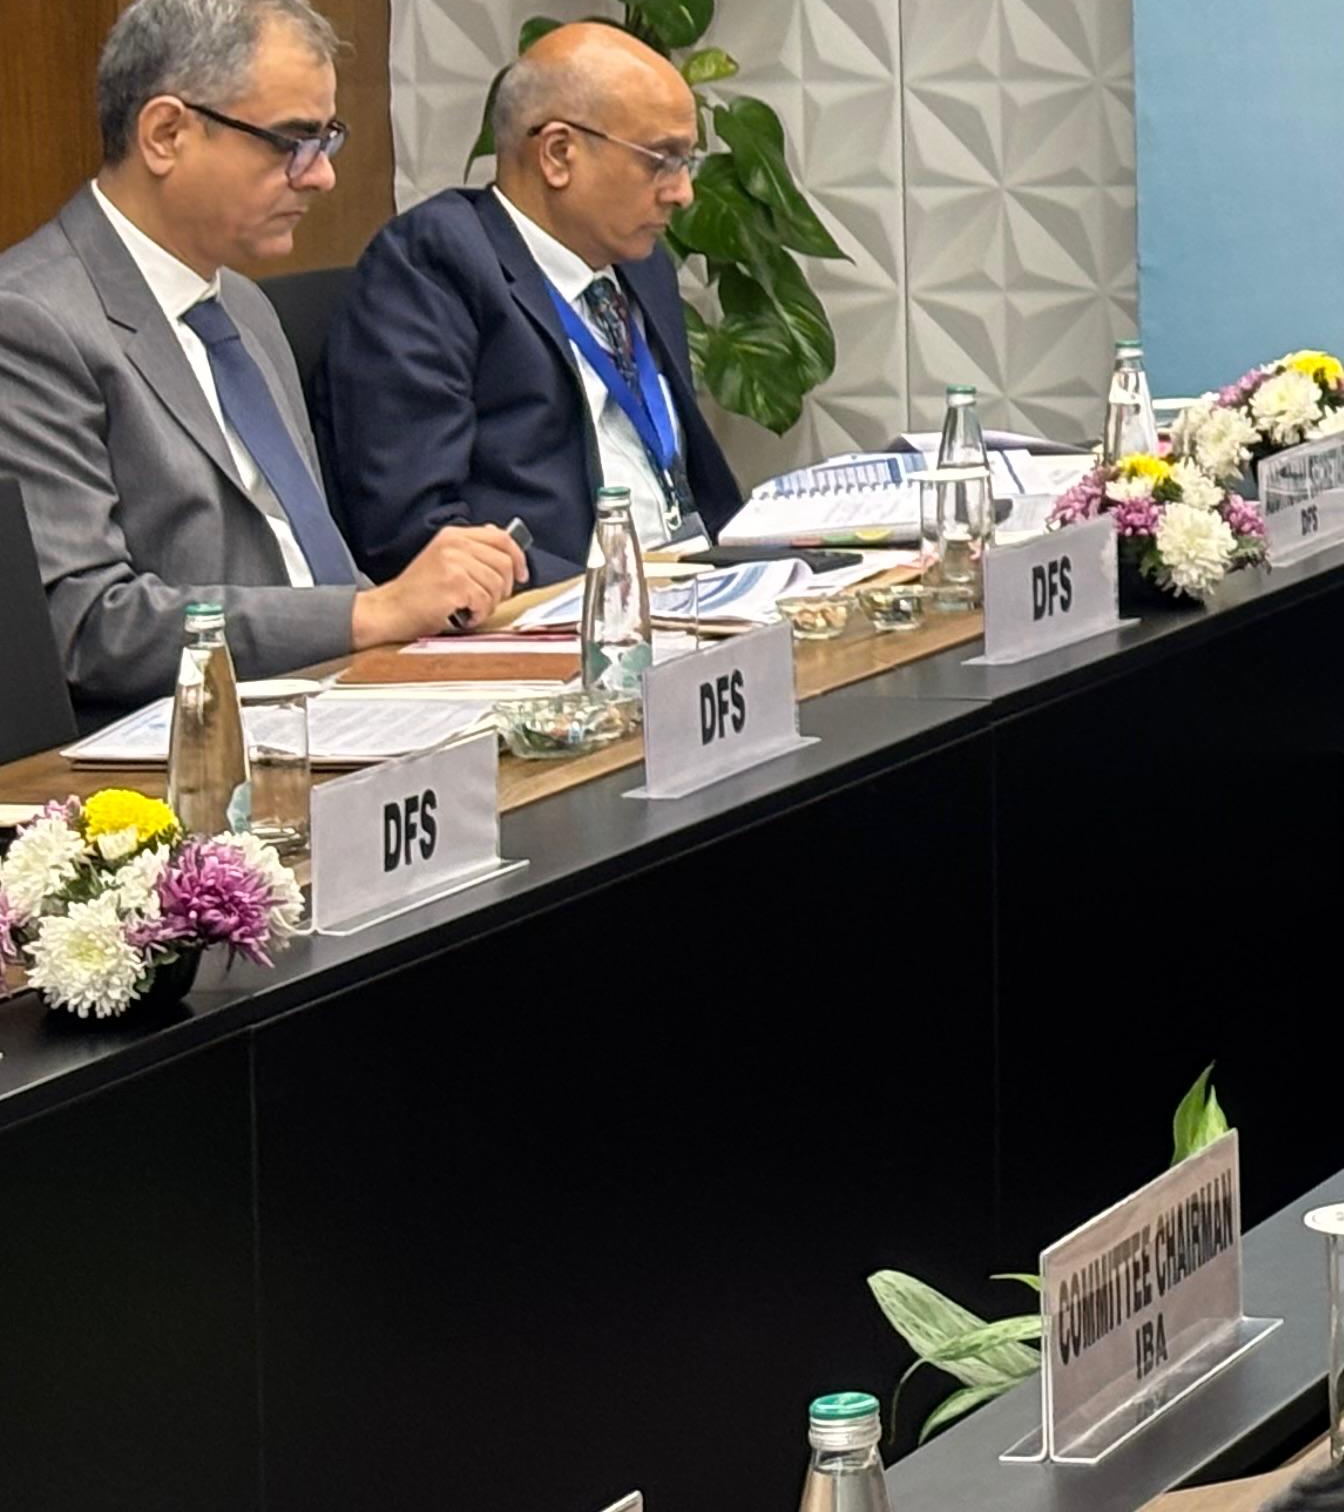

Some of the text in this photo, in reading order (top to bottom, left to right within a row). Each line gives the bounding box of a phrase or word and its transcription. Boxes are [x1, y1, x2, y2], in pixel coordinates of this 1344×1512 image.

[1033, 557, 1071, 620] DFS
[700, 669, 745, 745] DFS
[384, 788, 436, 872] DFS
[1058, 1169, 1233, 1365] COMMITTEE CHAIRMAN
[1136, 1312, 1168, 1380] IBA
